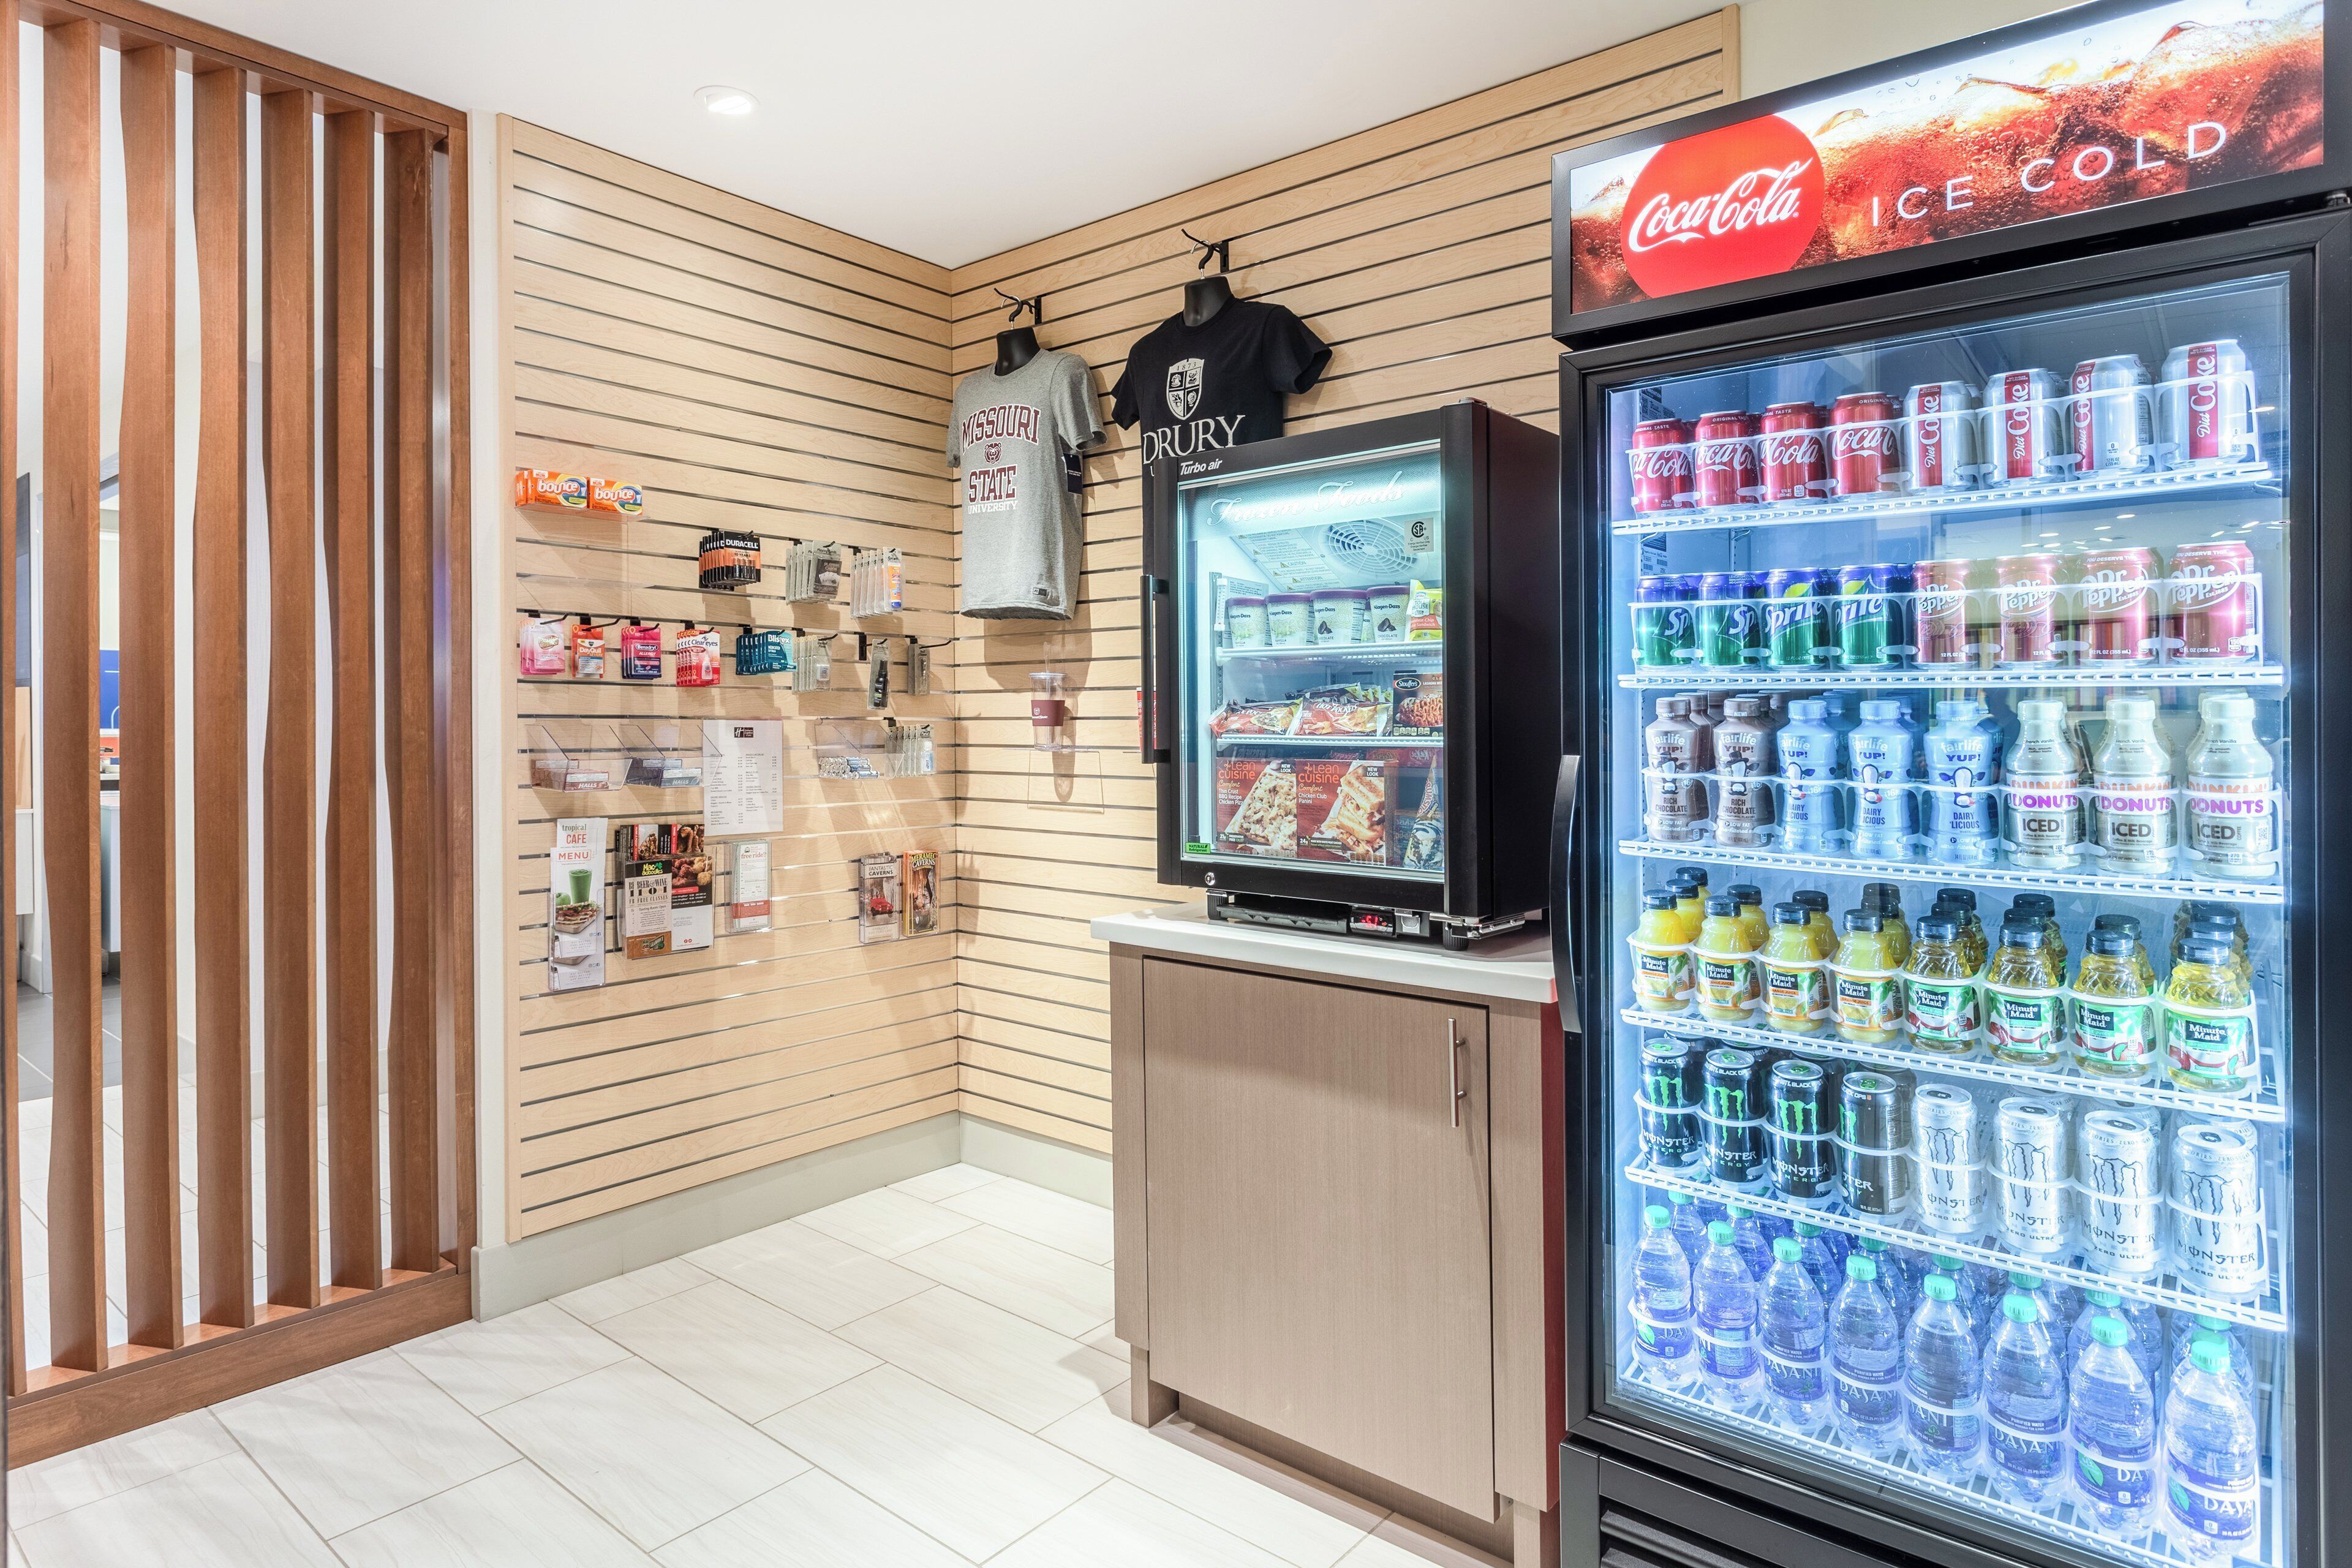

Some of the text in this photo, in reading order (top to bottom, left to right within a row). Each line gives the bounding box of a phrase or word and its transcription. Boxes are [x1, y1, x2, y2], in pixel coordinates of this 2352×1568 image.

[1871, 121, 2230, 227] ICE COLD
[1627, 157, 1812, 252] Coca-Cola
[1177, 362, 1197, 371] 1873
[2190, 356, 2216, 437] Diet Coke
[2075, 375, 2090, 456] Diet Coke
[962, 404, 1041, 452] MISSOURI
[2008, 385, 2029, 459] Diet Coke
[1143, 415, 1246, 465] DRURY
[1924, 445, 1936, 467] Diet
[1180, 459, 1223, 475] Turbo air
[538, 479, 579, 492] bounce
[968, 464, 1017, 503] STATE
[595, 488, 634, 500] bounce
[1207, 470, 1405, 527] Frozen Foods
[968, 500, 1018, 515] UNIVERSITY
[726, 540, 758, 549] DURACELL
[2097, 570, 2127, 582] Dr
[2184, 565, 2215, 578] Dr
[2206, 587, 2228, 597] Est.1885
[767, 634, 790, 643] Blistex
[1231, 762, 1255, 771] Lean
[1313, 765, 1339, 774] Lean
[2013, 794, 2077, 808] DONUTS
[2101, 797, 2170, 812] DONUTS
[2191, 797, 2263, 814] DONUTS
[1789, 804, 1805, 816] DAIRY
[1863, 808, 1882, 819] DAIRY
[1953, 812, 1975, 821] DAIRY
[1950, 820, 1980, 829] 'LICIOUS
[2022, 818, 2059, 832] ICED
[2112, 823, 2151, 837] ICED
[2198, 823, 2235, 840] ICED
[567, 834, 587, 843] CAFE
[913, 859, 935, 868] CAVERNS
[1643, 957, 1666, 965] Minute
[1707, 965, 1731, 973] Minute
[1773, 979, 1792, 987] Maid
[1841, 982, 1868, 991] Minute
[1845, 989, 1864, 997] Maid
[1918, 991, 1947, 1000] Minute
[1921, 998, 1942, 1007] Maid
[2007, 1003, 2038, 1012] Minute
[2081, 1009, 2110, 1021] Minute
[2084, 1017, 2106, 1028] Maid
[1643, 1130, 1694, 1147] MONSTER
[1705, 1142, 1757, 1160] MONSTER
[1772, 1156, 1829, 1176] MONSTER
[2006, 1227, 2027, 1237] ZERO
[2094, 1246, 2115, 1256] ZERO
[2178, 1239, 2255, 1264] MONSTER
[2190, 1266, 2213, 1276] ZERO
[2011, 1417, 2030, 1426] PURIFIED
